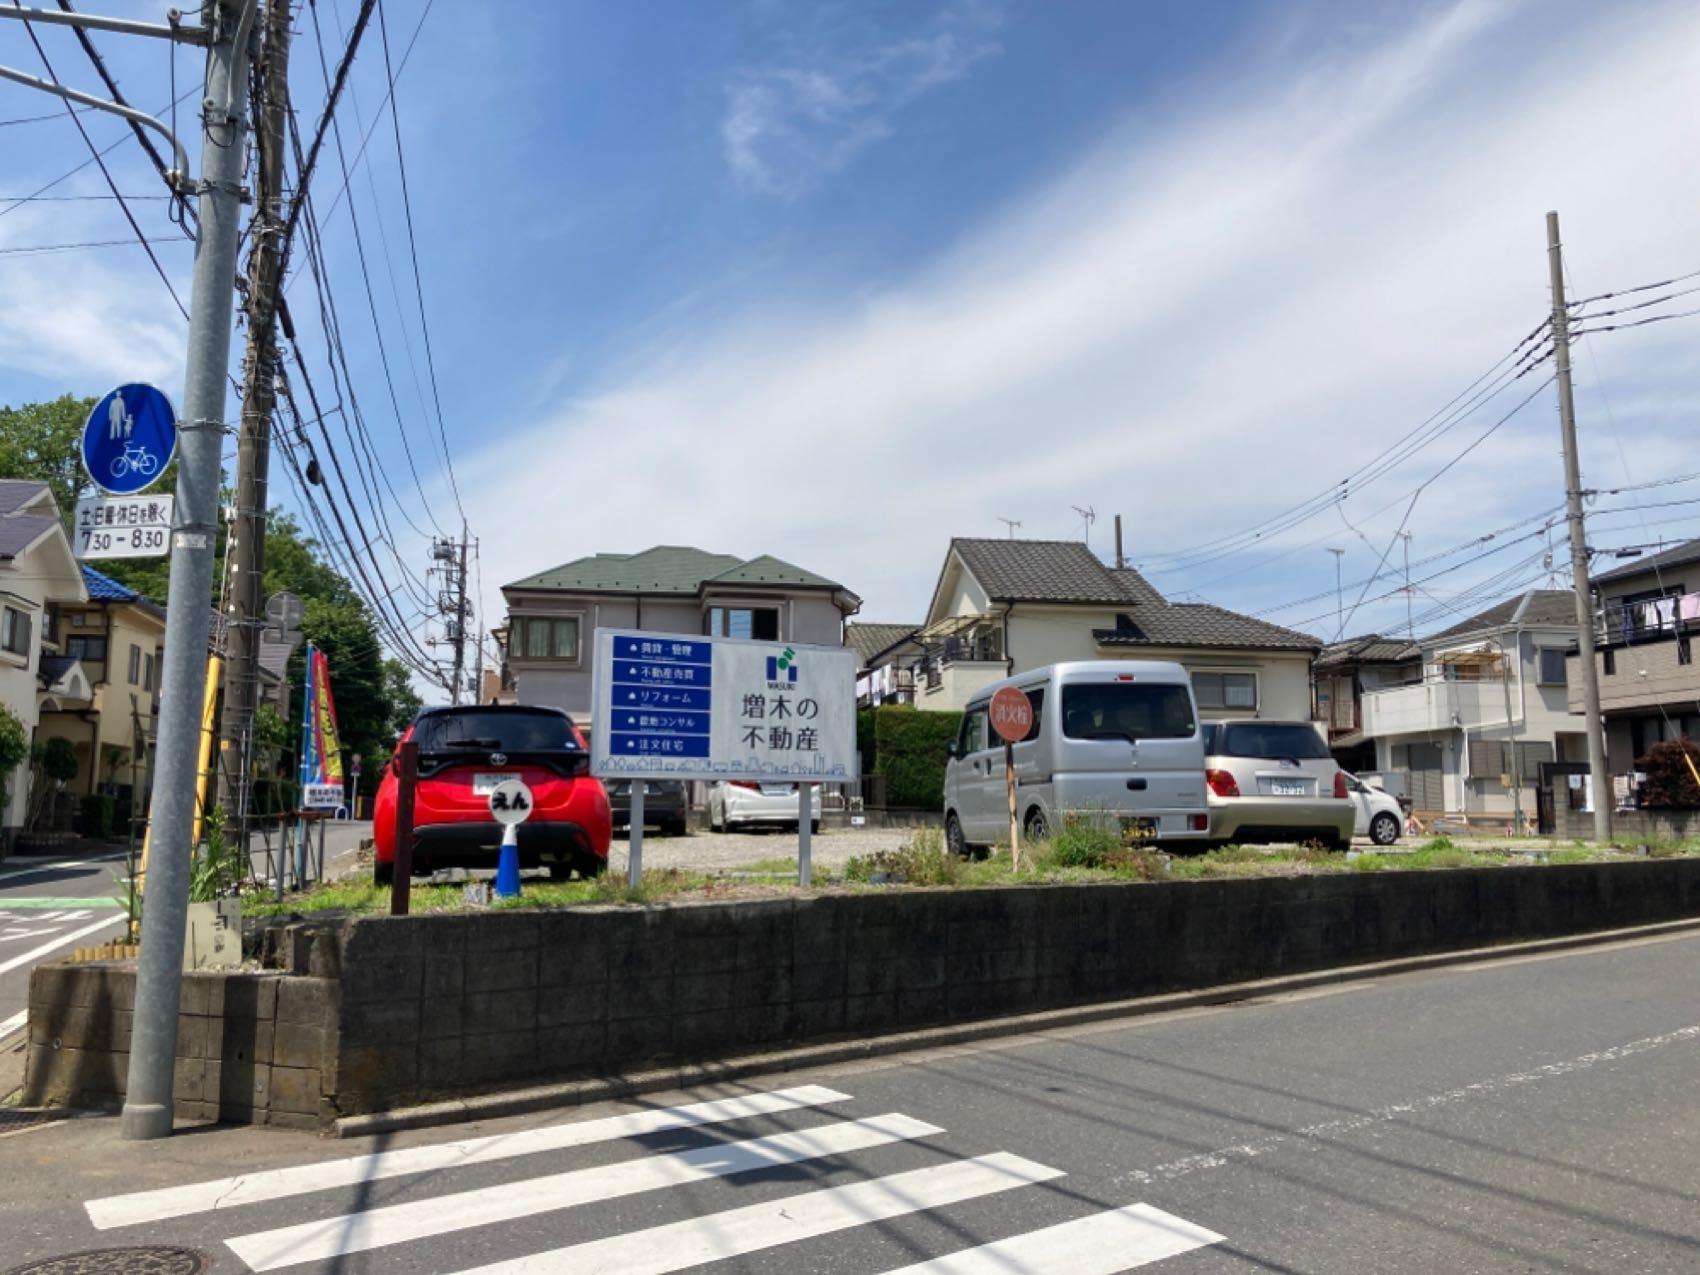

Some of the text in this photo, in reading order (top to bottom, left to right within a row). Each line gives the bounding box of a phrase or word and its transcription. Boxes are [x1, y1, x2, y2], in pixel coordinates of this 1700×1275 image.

[640, 691, 692, 703] リフォーム
[741, 693, 819, 720] 増木の
[994, 703, 1028, 725] 消火栓
[741, 725, 819, 751] 不動産
[491, 791, 530, 811] えん
